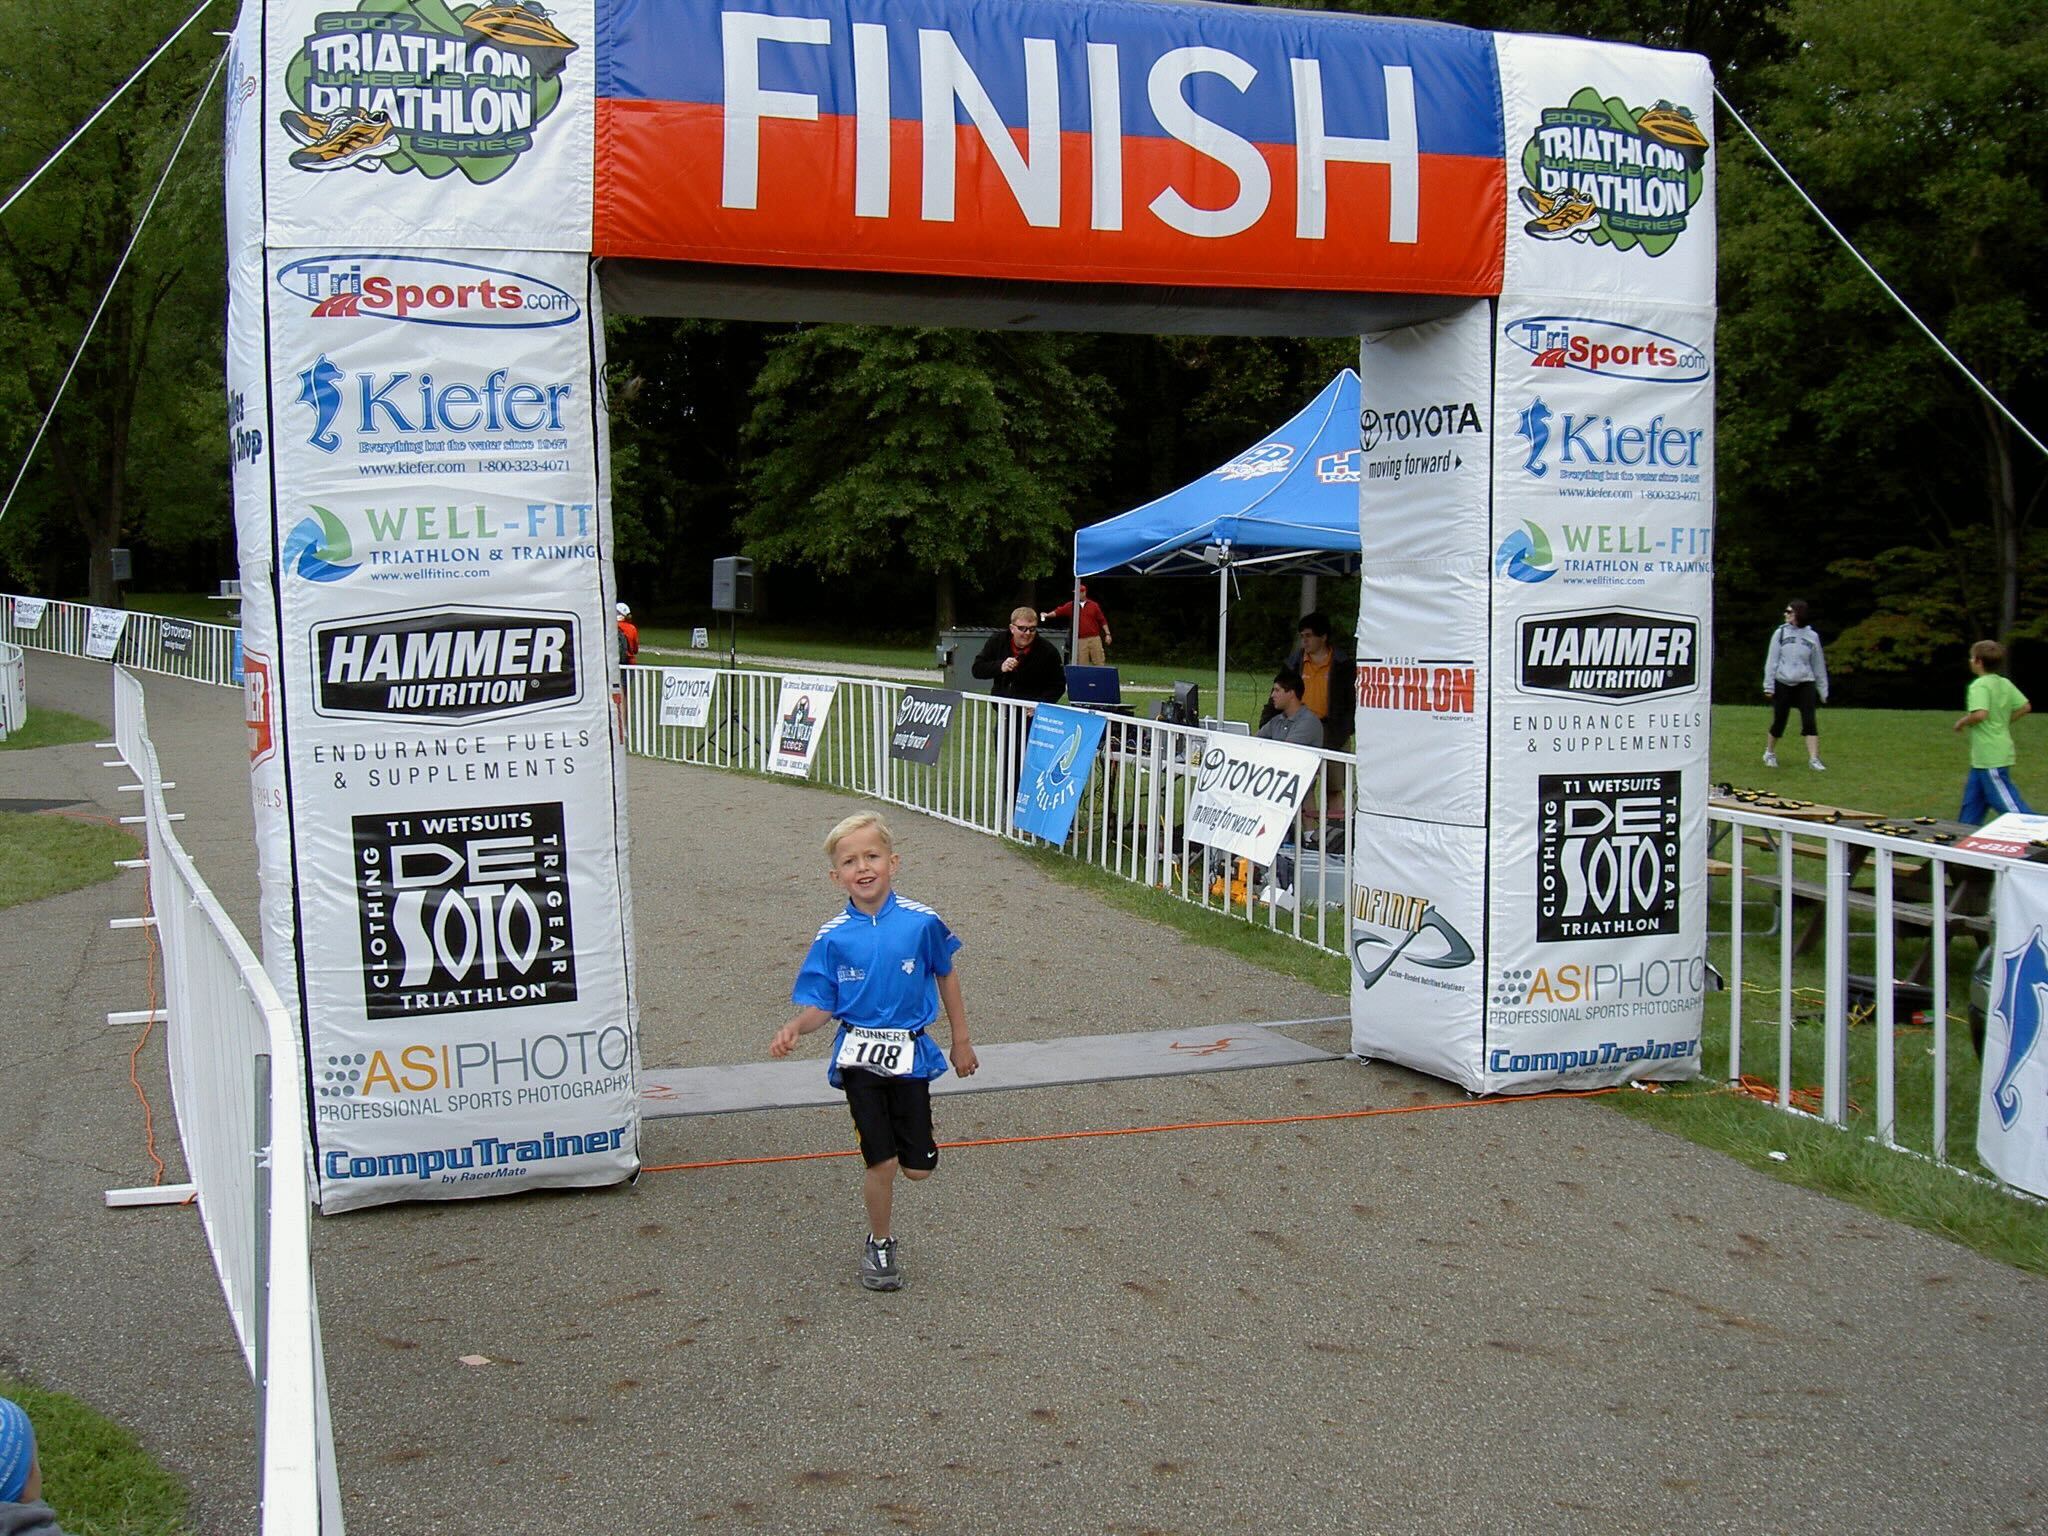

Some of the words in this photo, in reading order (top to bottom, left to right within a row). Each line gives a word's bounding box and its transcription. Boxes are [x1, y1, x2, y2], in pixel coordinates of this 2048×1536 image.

[321, 18, 417, 31] 2007
[311, 33, 531, 80] TRIATHLON
[317, 71, 463, 89] WHEELIE
[468, 74, 532, 91] FUN
[311, 83, 531, 136] DUATHLON
[1545, 114, 1607, 126] 2007
[721, 11, 1419, 244] FINISH
[417, 136, 527, 152] SERIES
[1539, 127, 1685, 172] TRIATHLON
[1645, 167, 1685, 181] FUN
[1540, 167, 1685, 217] DUATHLON
[1610, 217, 1683, 230] SERIES
[356, 367, 572, 433] Kiefer
[1384, 403, 1483, 441] TOYOTA
[359, 441, 423, 454] Everything
[424, 440, 445, 451] but
[448, 440, 466, 451] the
[469, 440, 500, 451] water
[503, 439, 534, 450] since
[1559, 413, 1703, 467] Kiefer
[359, 461, 465, 475] www.kiefer.com
[478, 460, 570, 473] 1-800-323-4071
[1369, 456, 1402, 480] moving
[1404, 450, 1451, 475] forward
[1560, 488, 1632, 499] www.kiefer.com
[365, 504, 592, 541] WELL-FIT
[1562, 525, 1710, 554] WELL-FIT
[369, 548, 480, 565] TRIATHLON
[489, 549, 503, 561] &
[512, 544, 596, 560] TRAINING
[1564, 560, 1638, 572] TRIATHLON
[1644, 561, 1653, 571] &
[371, 568, 490, 581] www.wellfitinc.com
[1563, 575, 1645, 585] www.wellfitinc.com
[327, 626, 567, 684] HAMMER
[1384, 657, 1415, 665] INSIDE
[1527, 627, 1692, 667] HAMMER
[677, 680, 710, 697] TOYOTA
[1569, 670, 1664, 689] NUTRITION
[387, 679, 527, 709] NUTRITION
[909, 701, 952, 727] TOYOTA
[1514, 715, 1635, 731] ENDURANCE
[1649, 713, 1701, 728] FUELS
[315, 736, 486, 764] ENDURANCE
[508, 730, 589, 751] FUELS
[1527, 739, 1537, 752] &
[1553, 735, 1692, 752] SUPPLEMENTS
[334, 772, 347, 789] &
[369, 757, 575, 787] SUPPLEMENTS
[1220, 759, 1301, 808] TOYOTA
[1563, 781, 1580, 793] T1
[1588, 778, 1661, 793] WETSUITS
[387, 820, 411, 837] T1
[422, 812, 533, 835] WETSUITS
[1564, 797, 1661, 836] DE
[390, 835, 537, 889] DE
[1543, 801, 1557, 917] CLOTHING
[1561, 835, 1661, 917] SOTO
[363, 847, 389, 988] CLOTHING
[1561, 918, 1660, 935] TRIATHLON
[393, 882, 542, 988] SOTO
[400, 983, 547, 1010] TRIATHLON
[1490, 1007, 1582, 1025] PROFESSIONAL
[1585, 1003, 1629, 1020] SPORTS
[856, 1042, 902, 1070] 108
[1490, 1039, 1697, 1074] CompuTrainer
[319, 1097, 442, 1121] PROFESSIONAL
[448, 1090, 512, 1112] SPORTS
[518, 1073, 629, 1105] PHOTOGRAPHY
[326, 1126, 625, 1180] CompuTrainer
[441, 1172, 457, 1185] by
[461, 1166, 527, 1182] RacerMate
